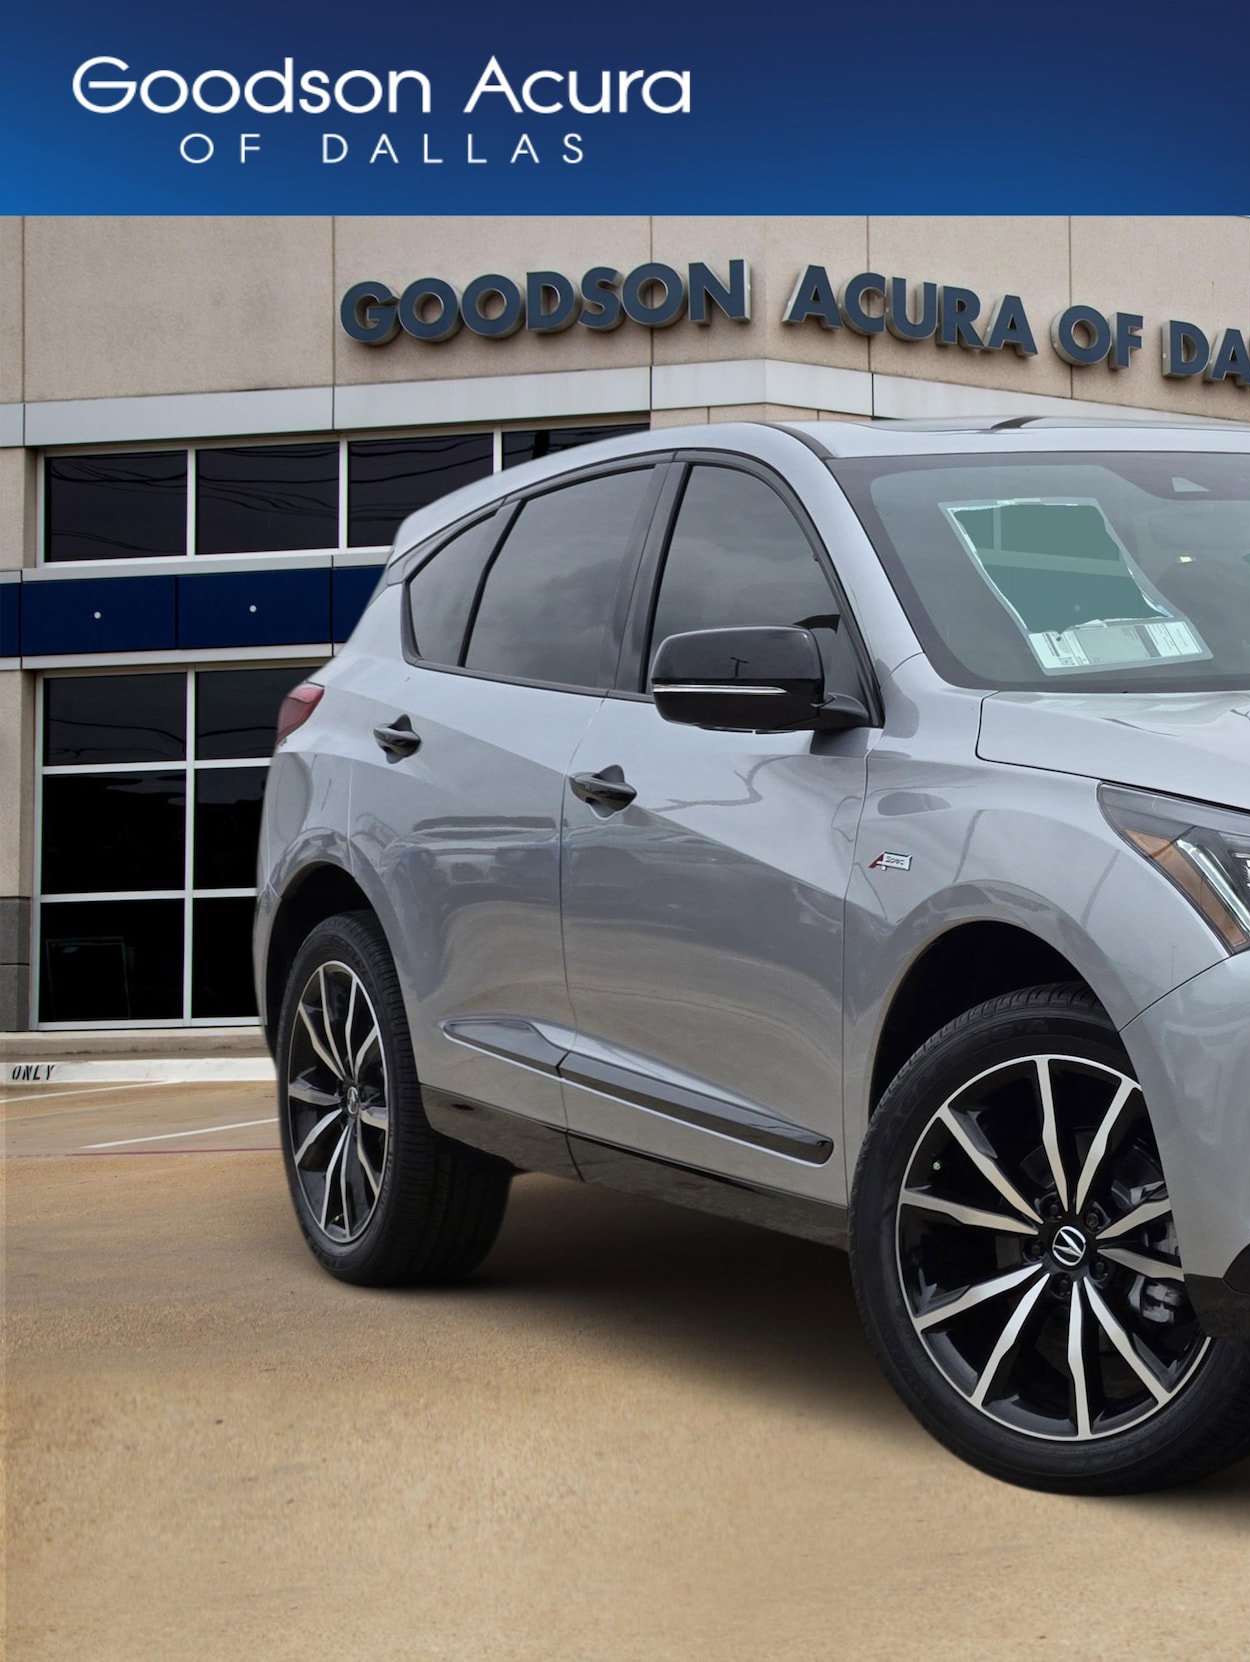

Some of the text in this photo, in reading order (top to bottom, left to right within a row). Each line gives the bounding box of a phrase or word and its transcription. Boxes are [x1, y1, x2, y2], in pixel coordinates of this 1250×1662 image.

[340, 258, 751, 347] GOODSON
[783, 263, 1038, 357] ACURA
[1050, 304, 1144, 371] OF
[12, 1065, 55, 1080] ONLY
